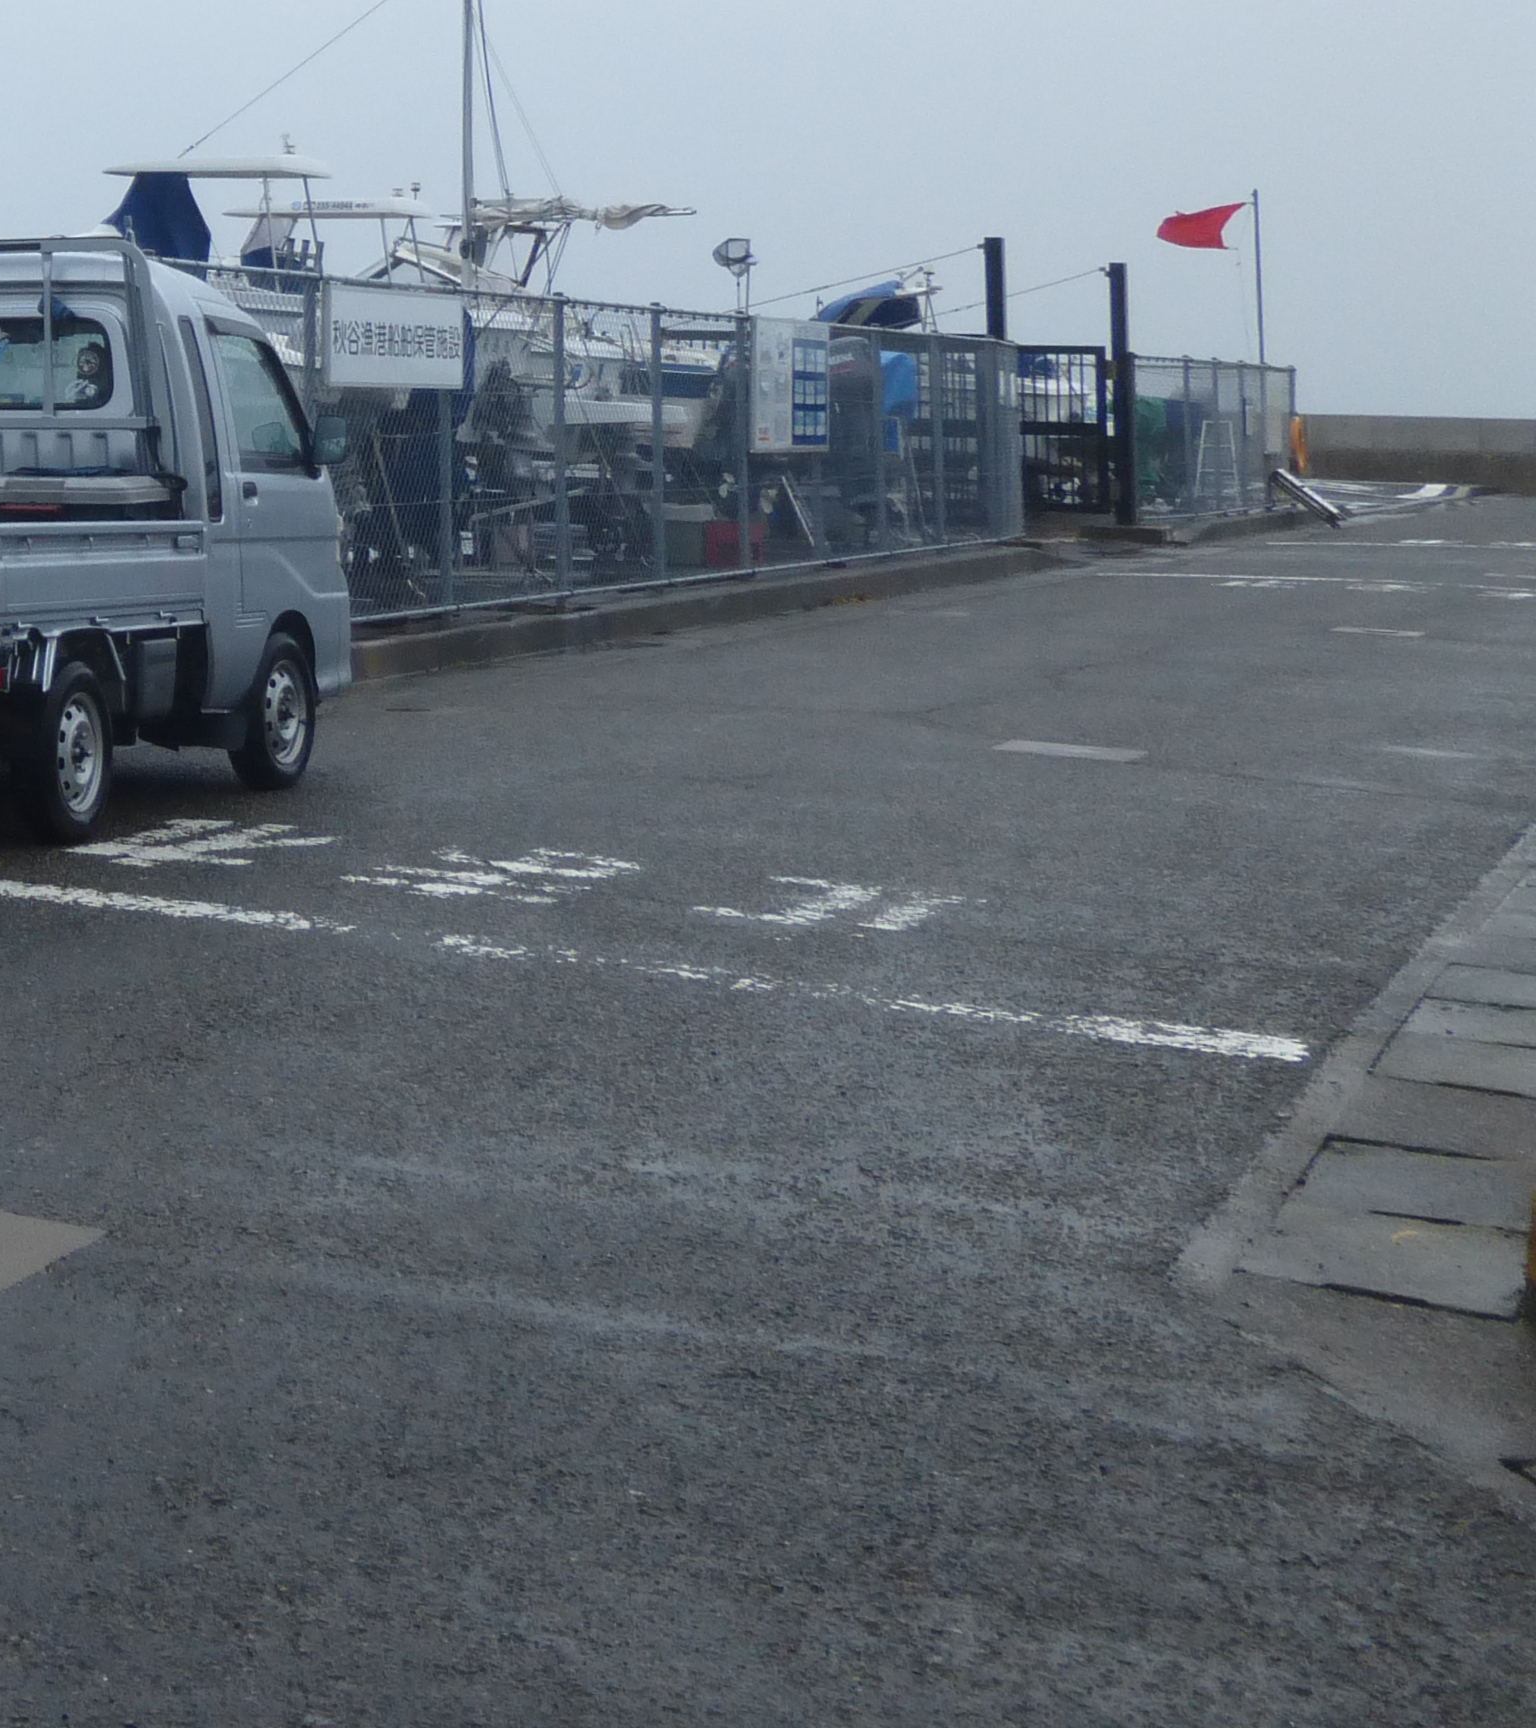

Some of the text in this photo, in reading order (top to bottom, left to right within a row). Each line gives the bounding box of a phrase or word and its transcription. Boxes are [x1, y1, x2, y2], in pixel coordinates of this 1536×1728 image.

[332, 319, 461, 360] 秋谷漁港船舶保管施設
